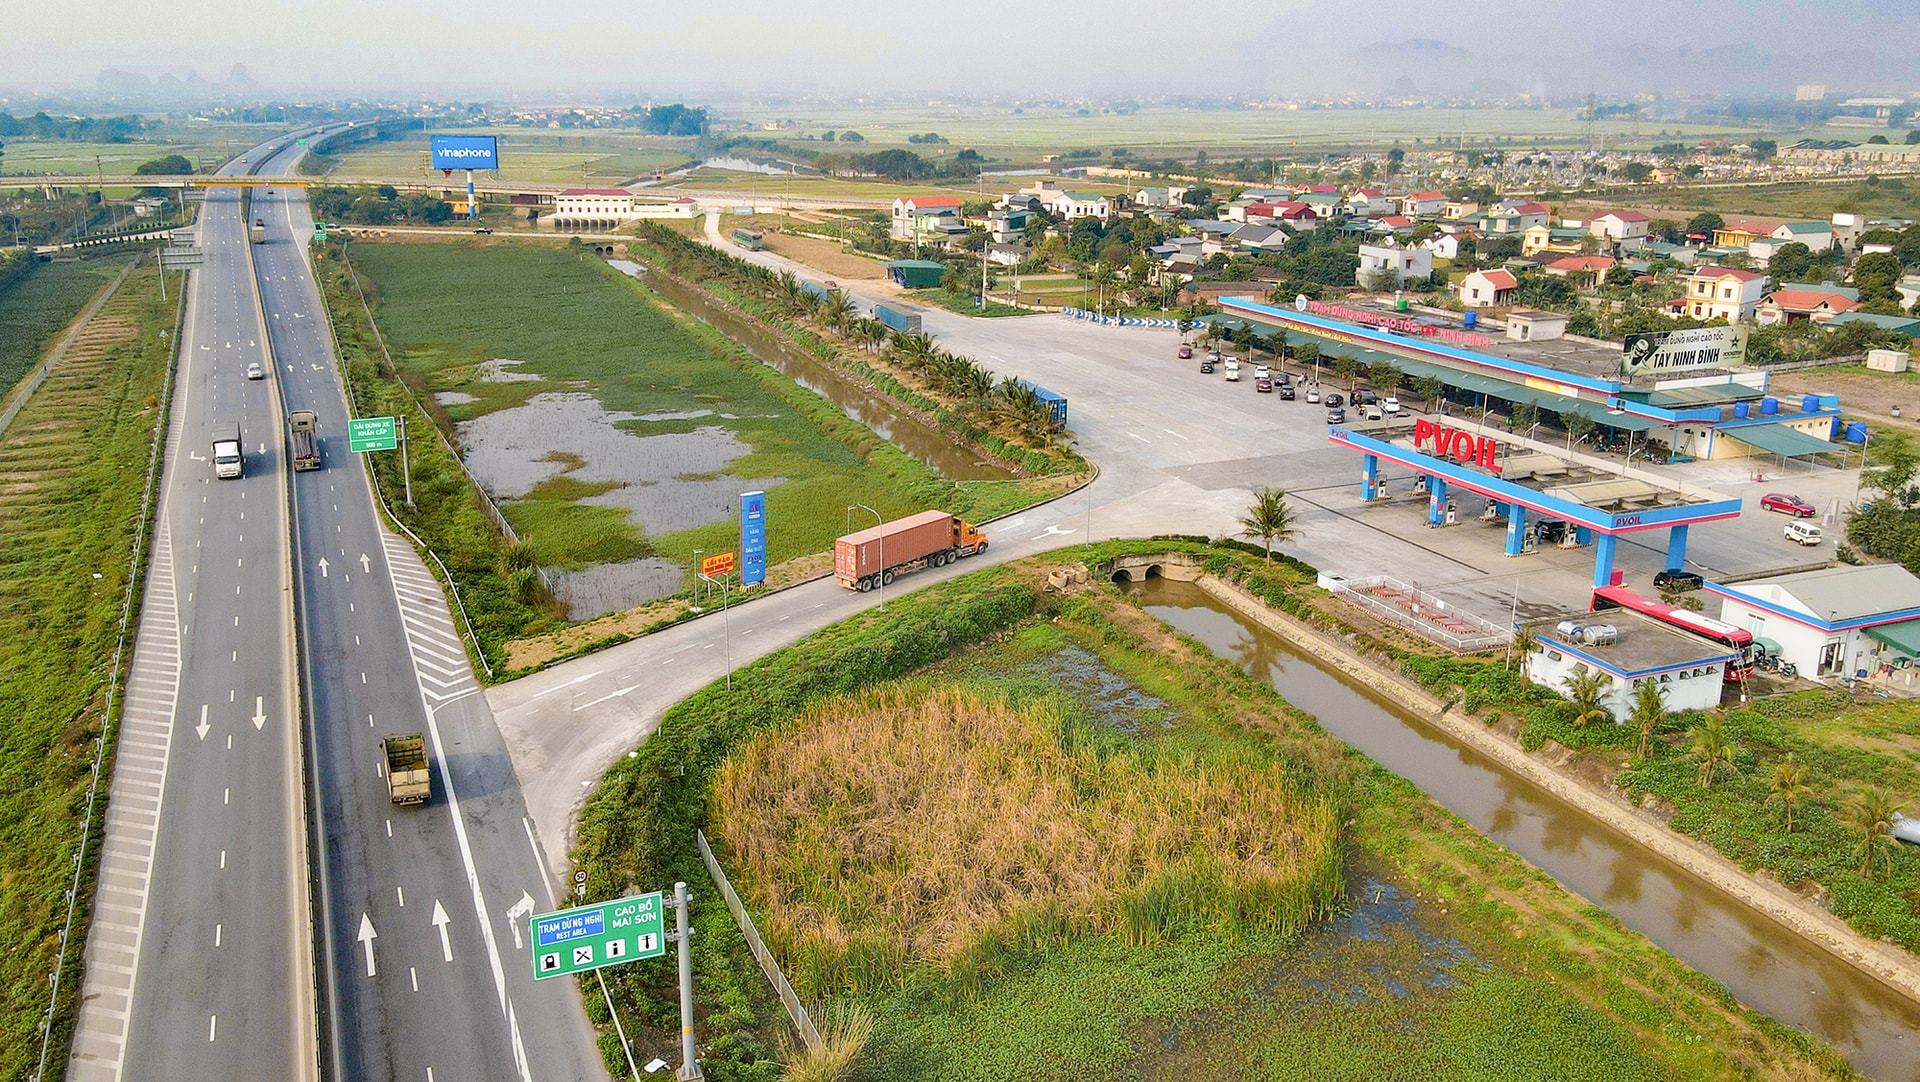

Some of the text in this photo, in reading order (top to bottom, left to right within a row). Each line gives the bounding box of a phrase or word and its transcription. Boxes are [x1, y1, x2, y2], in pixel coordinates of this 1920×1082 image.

[437, 148, 491, 159] vinaphone
[1378, 317, 1398, 330] CAO
[1399, 318, 1418, 334] TỐC
[1419, 323, 1437, 338] TÂY
[1440, 330, 1464, 343] NINH
[1466, 334, 1491, 348] BÌNH
[1701, 333, 1713, 343] CAO
[1653, 346, 1721, 369] TÂY NINH BÌNH
[1414, 418, 1504, 474] PVOIL
[1616, 515, 1642, 527] PVOIL
[577, 872, 586, 880] 50
[614, 905, 636, 917] CAO
[539, 911, 603, 934] TRẠM DỪNG NGHỈ
[612, 911, 657, 929] MAI SƠN
[556, 928, 587, 940] REST AREA
